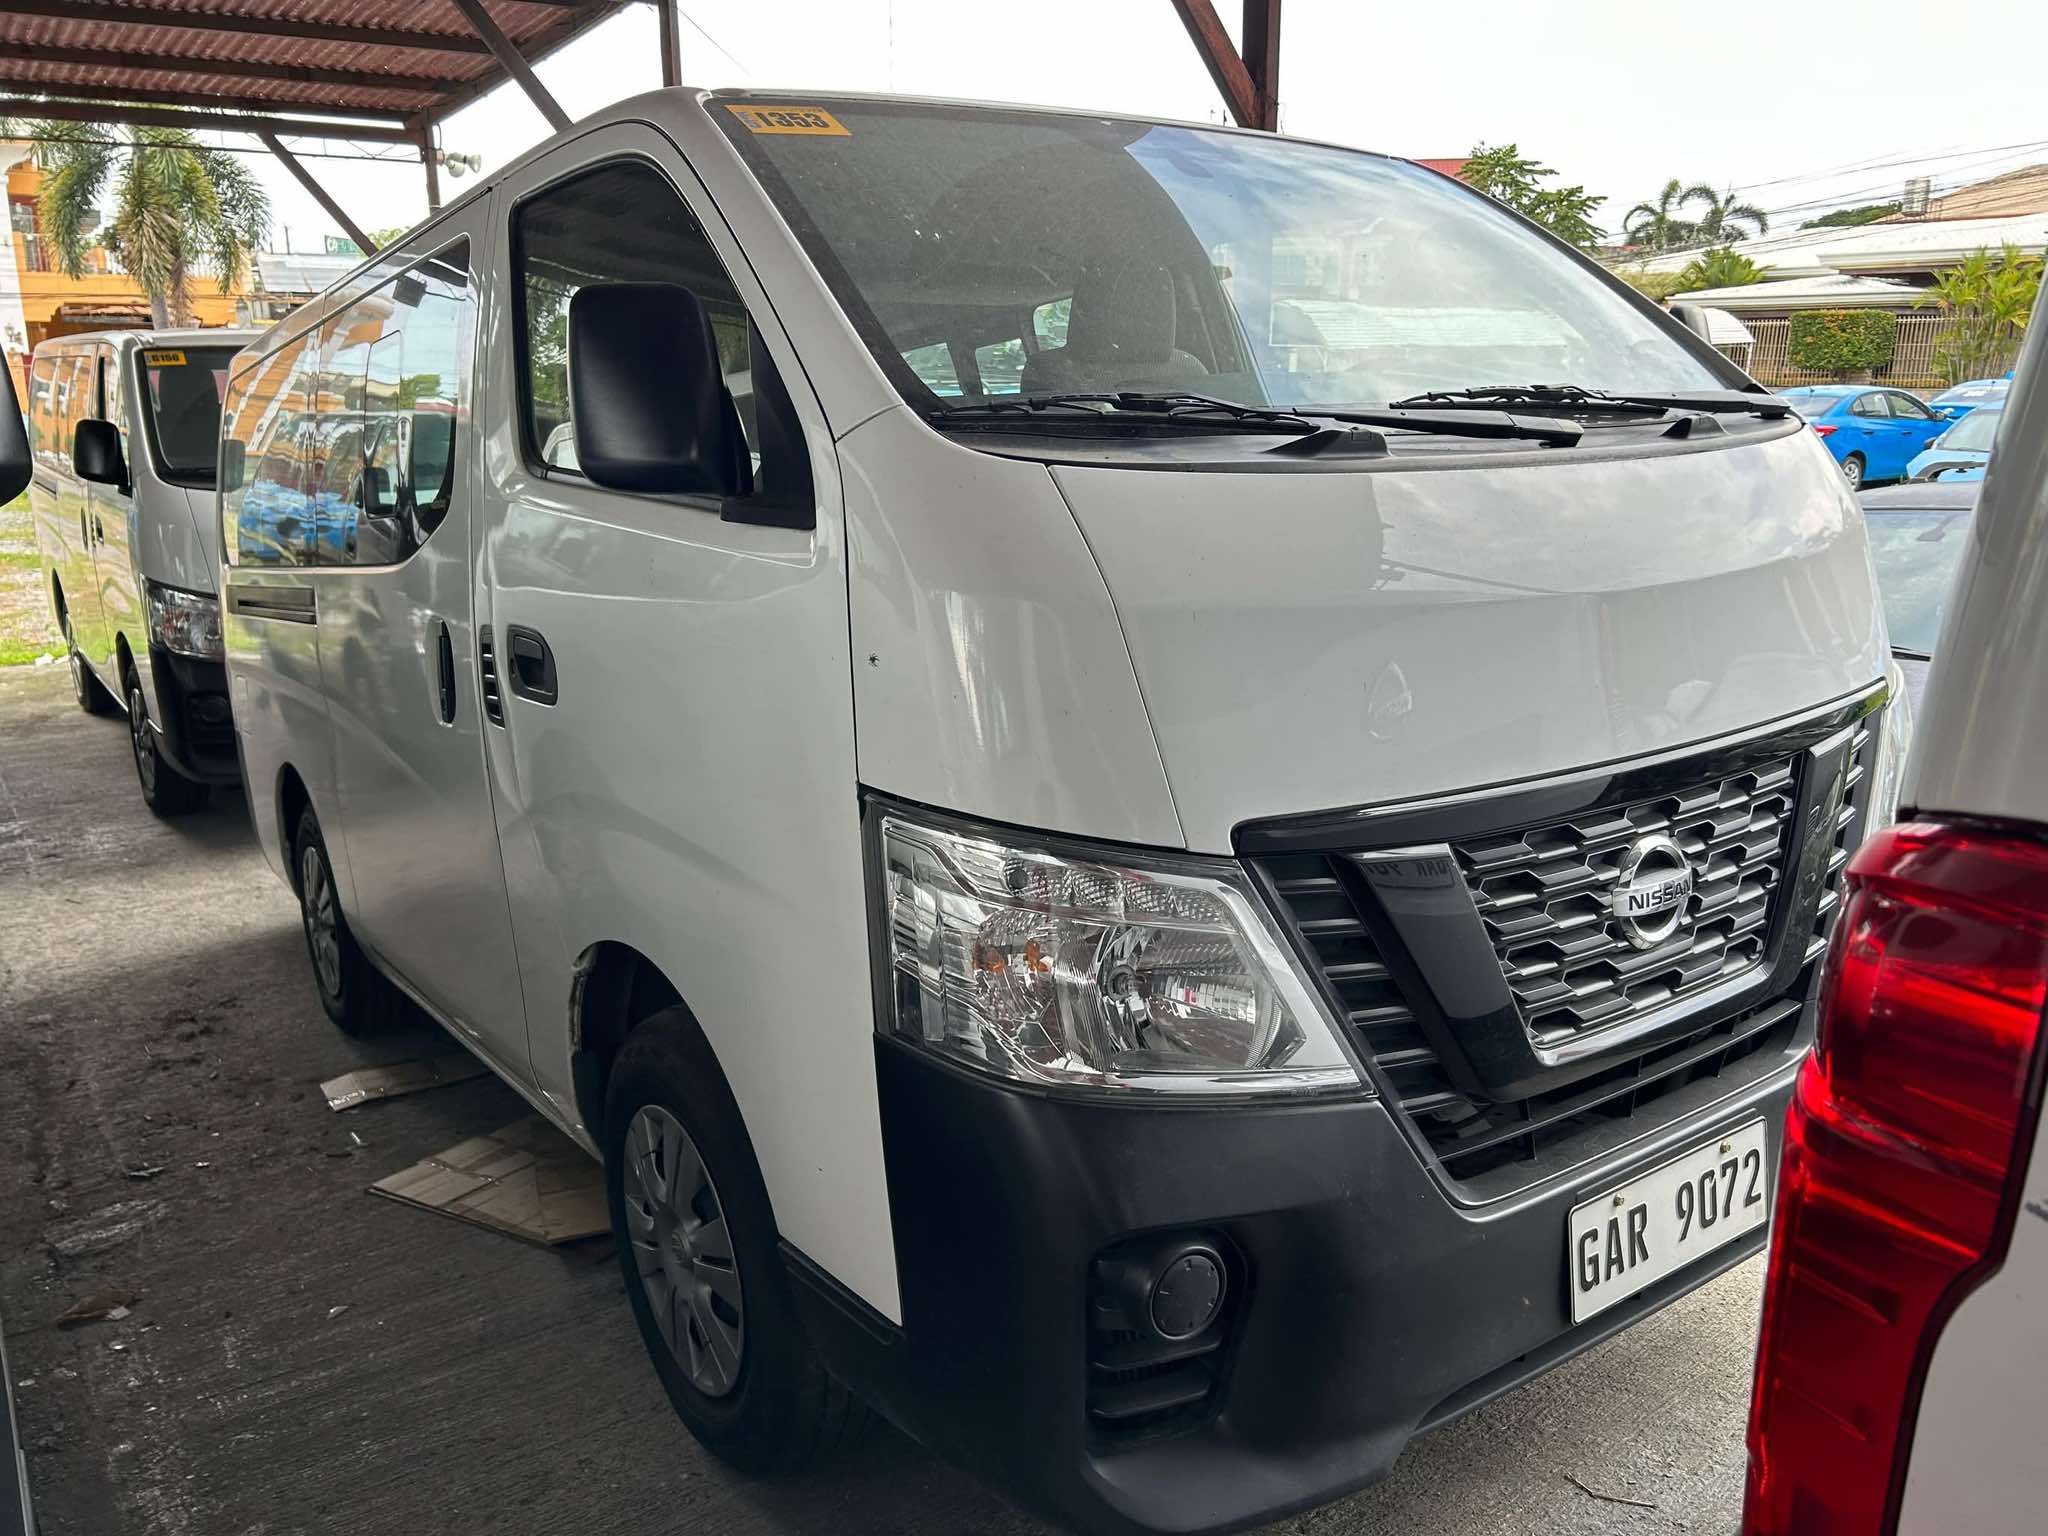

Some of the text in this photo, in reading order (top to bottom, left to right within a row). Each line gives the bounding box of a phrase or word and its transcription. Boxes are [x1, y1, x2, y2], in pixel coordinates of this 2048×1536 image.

[1628, 879, 1691, 911] NISSAN
[1579, 1149, 1762, 1292] GAR 9072
